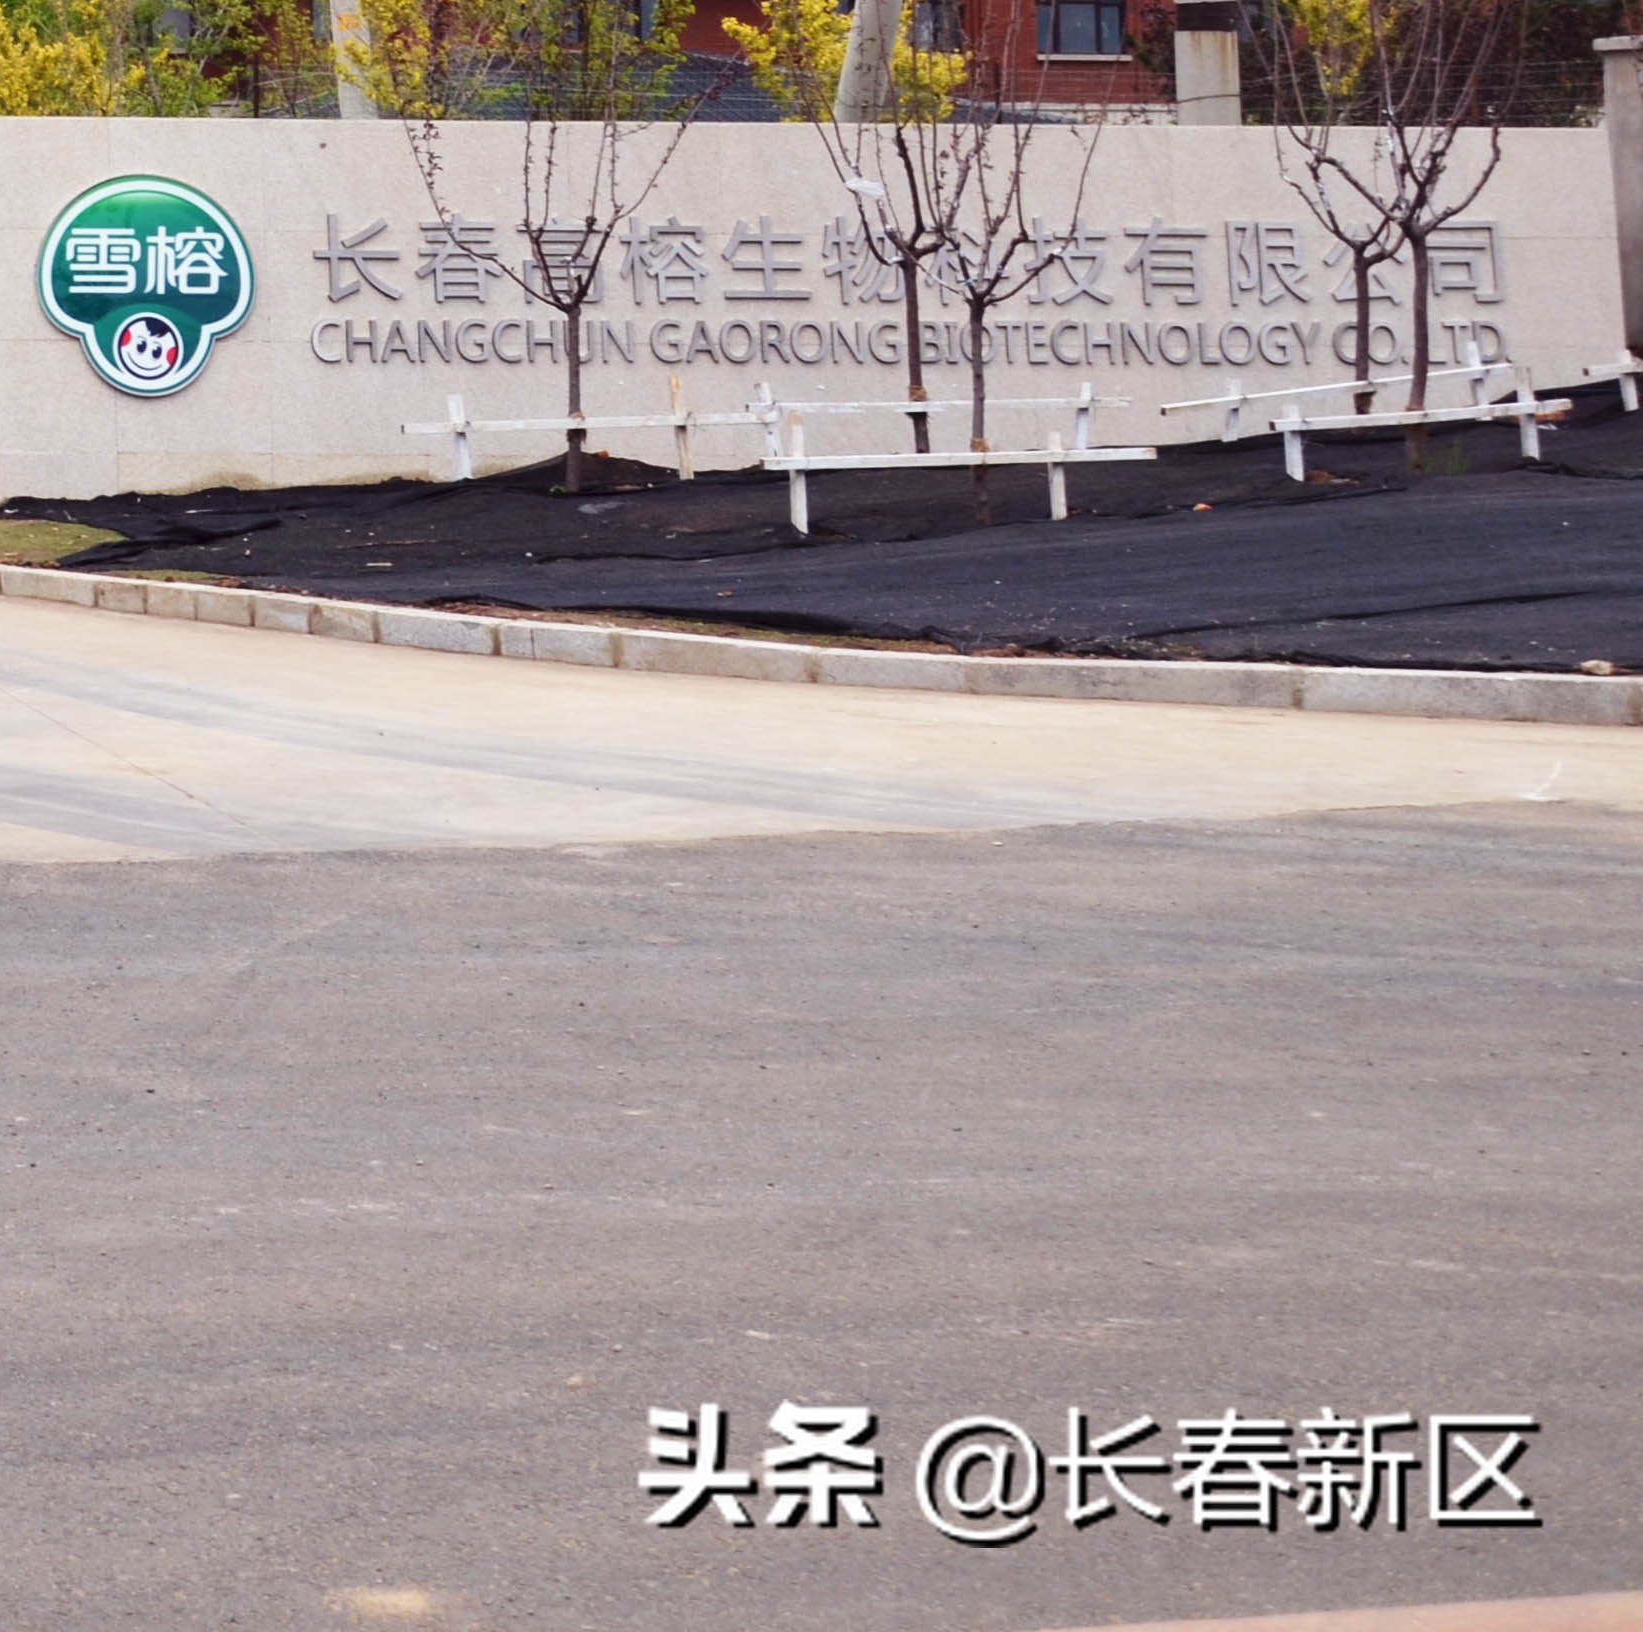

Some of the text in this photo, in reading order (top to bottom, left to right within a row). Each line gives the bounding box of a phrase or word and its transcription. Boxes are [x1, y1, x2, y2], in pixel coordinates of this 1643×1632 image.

[66, 226, 228, 294] 雪榕
[313, 214, 1503, 306] 长春高榕生物科技有限公司
[311, 319, 634, 364] CHANGCHUN
[649, 320, 901, 365] GAORONG
[918, 320, 1319, 366] BIOTECHNOLOGY
